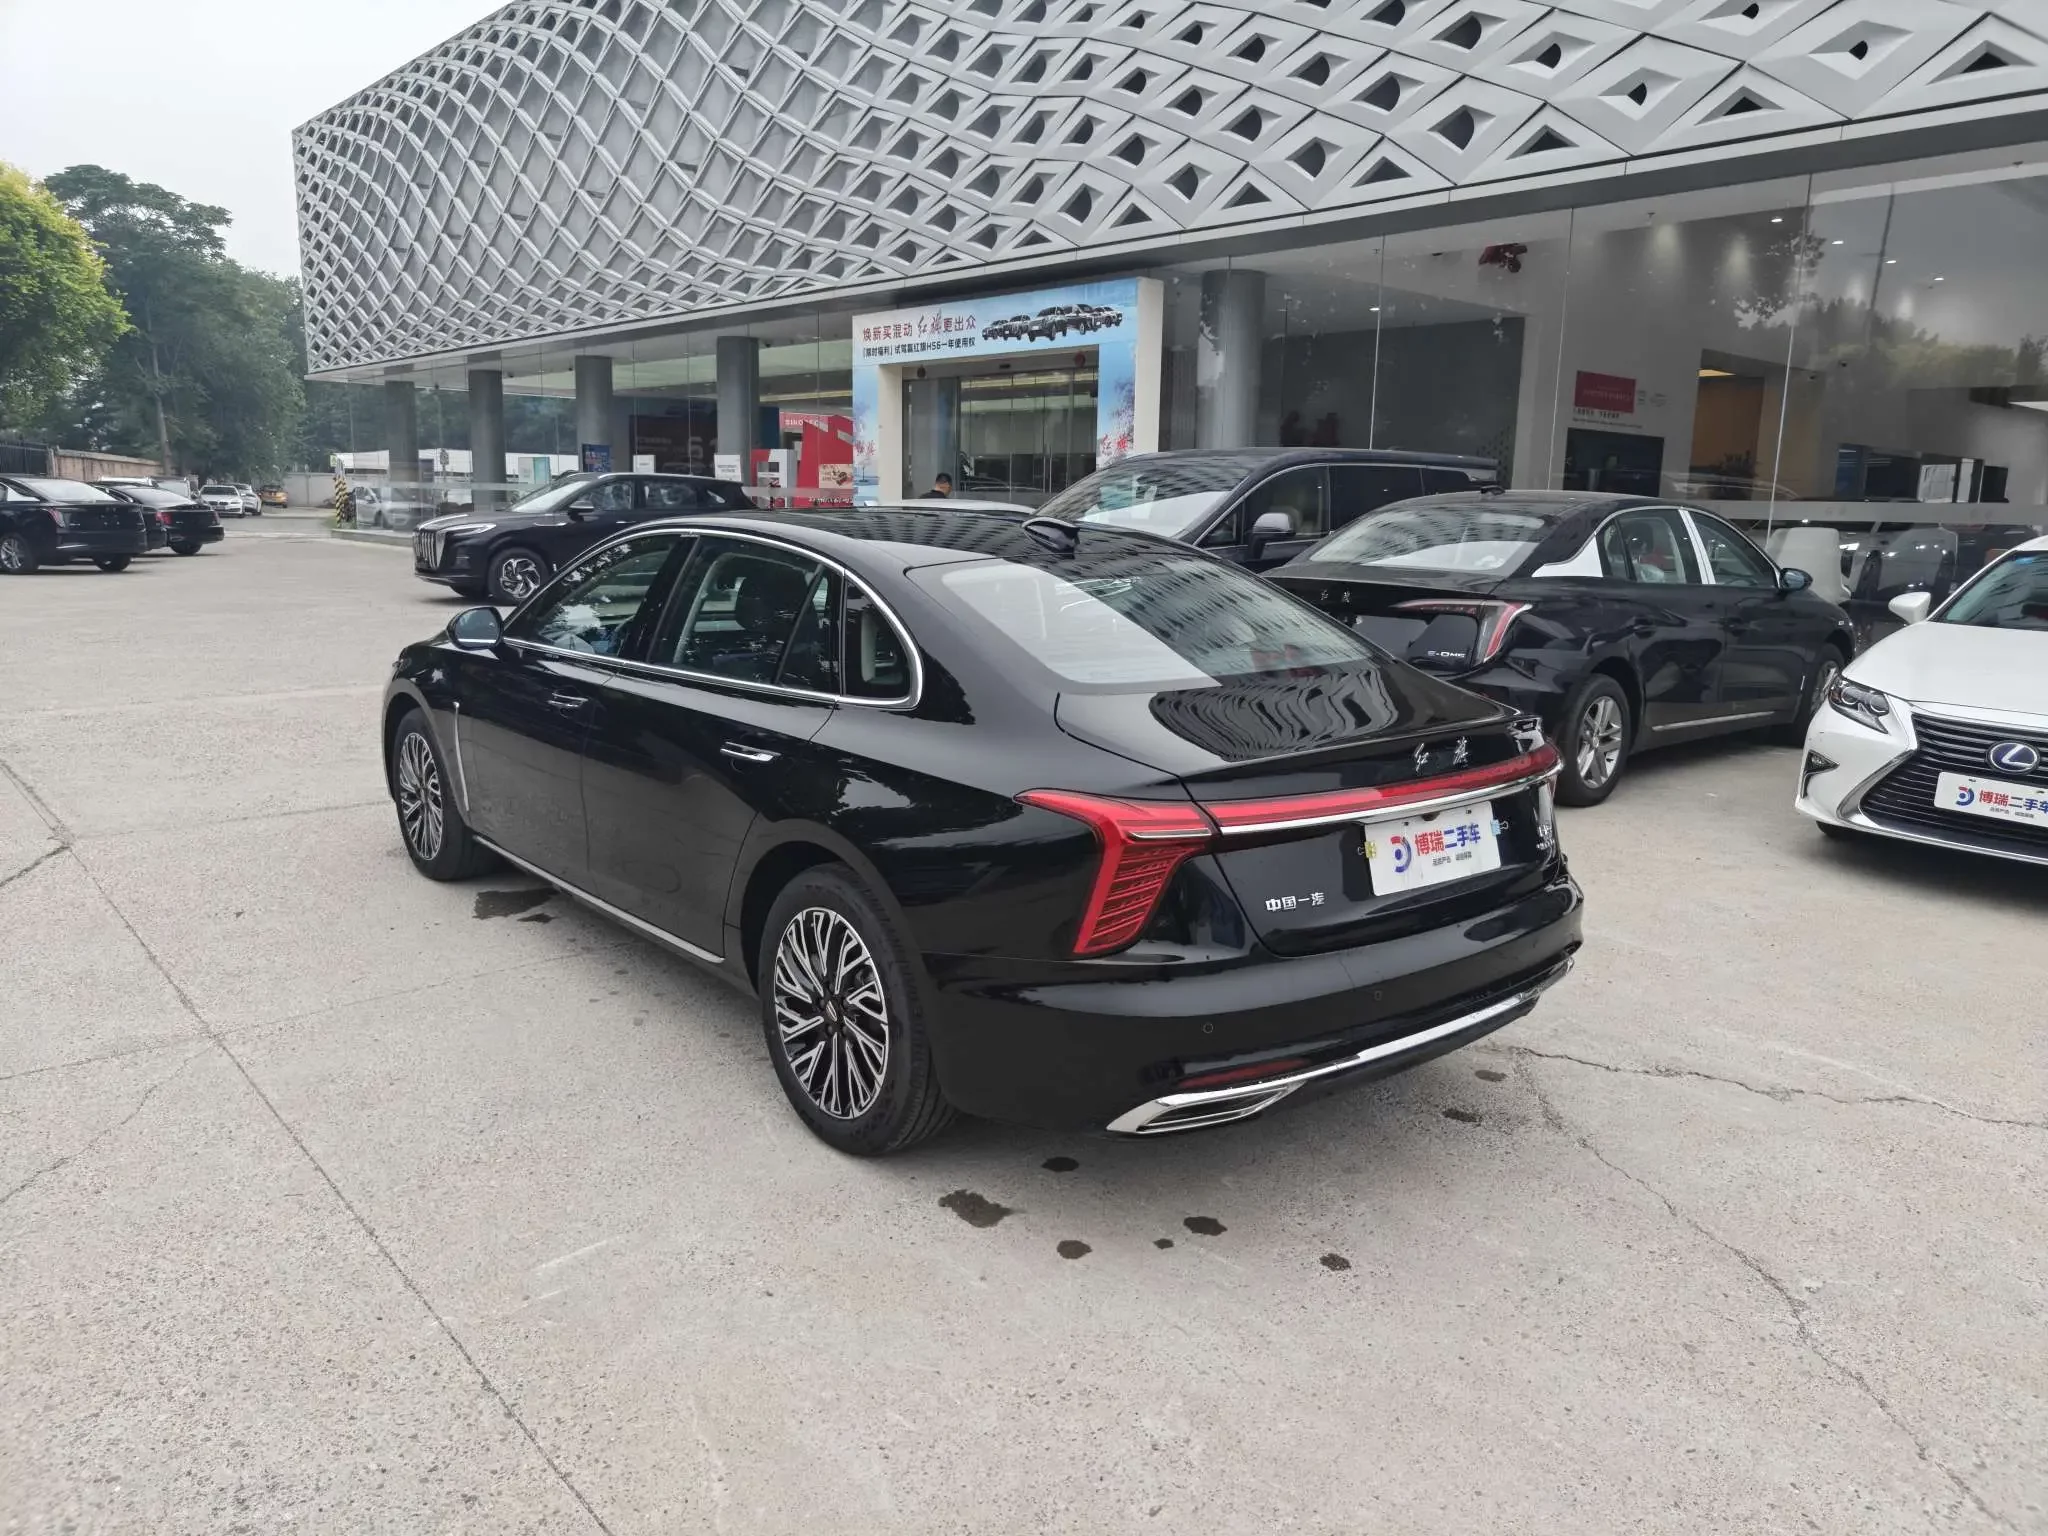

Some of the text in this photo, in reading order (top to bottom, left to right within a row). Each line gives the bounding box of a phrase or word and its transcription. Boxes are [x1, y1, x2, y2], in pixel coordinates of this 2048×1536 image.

[863, 323, 913, 341] 焕新买混动
[1980, 789, 2048, 814] 博瑞二手车
[1415, 823, 1481, 856] 博瑞二手车
[1265, 892, 1325, 912] 中国一汽
